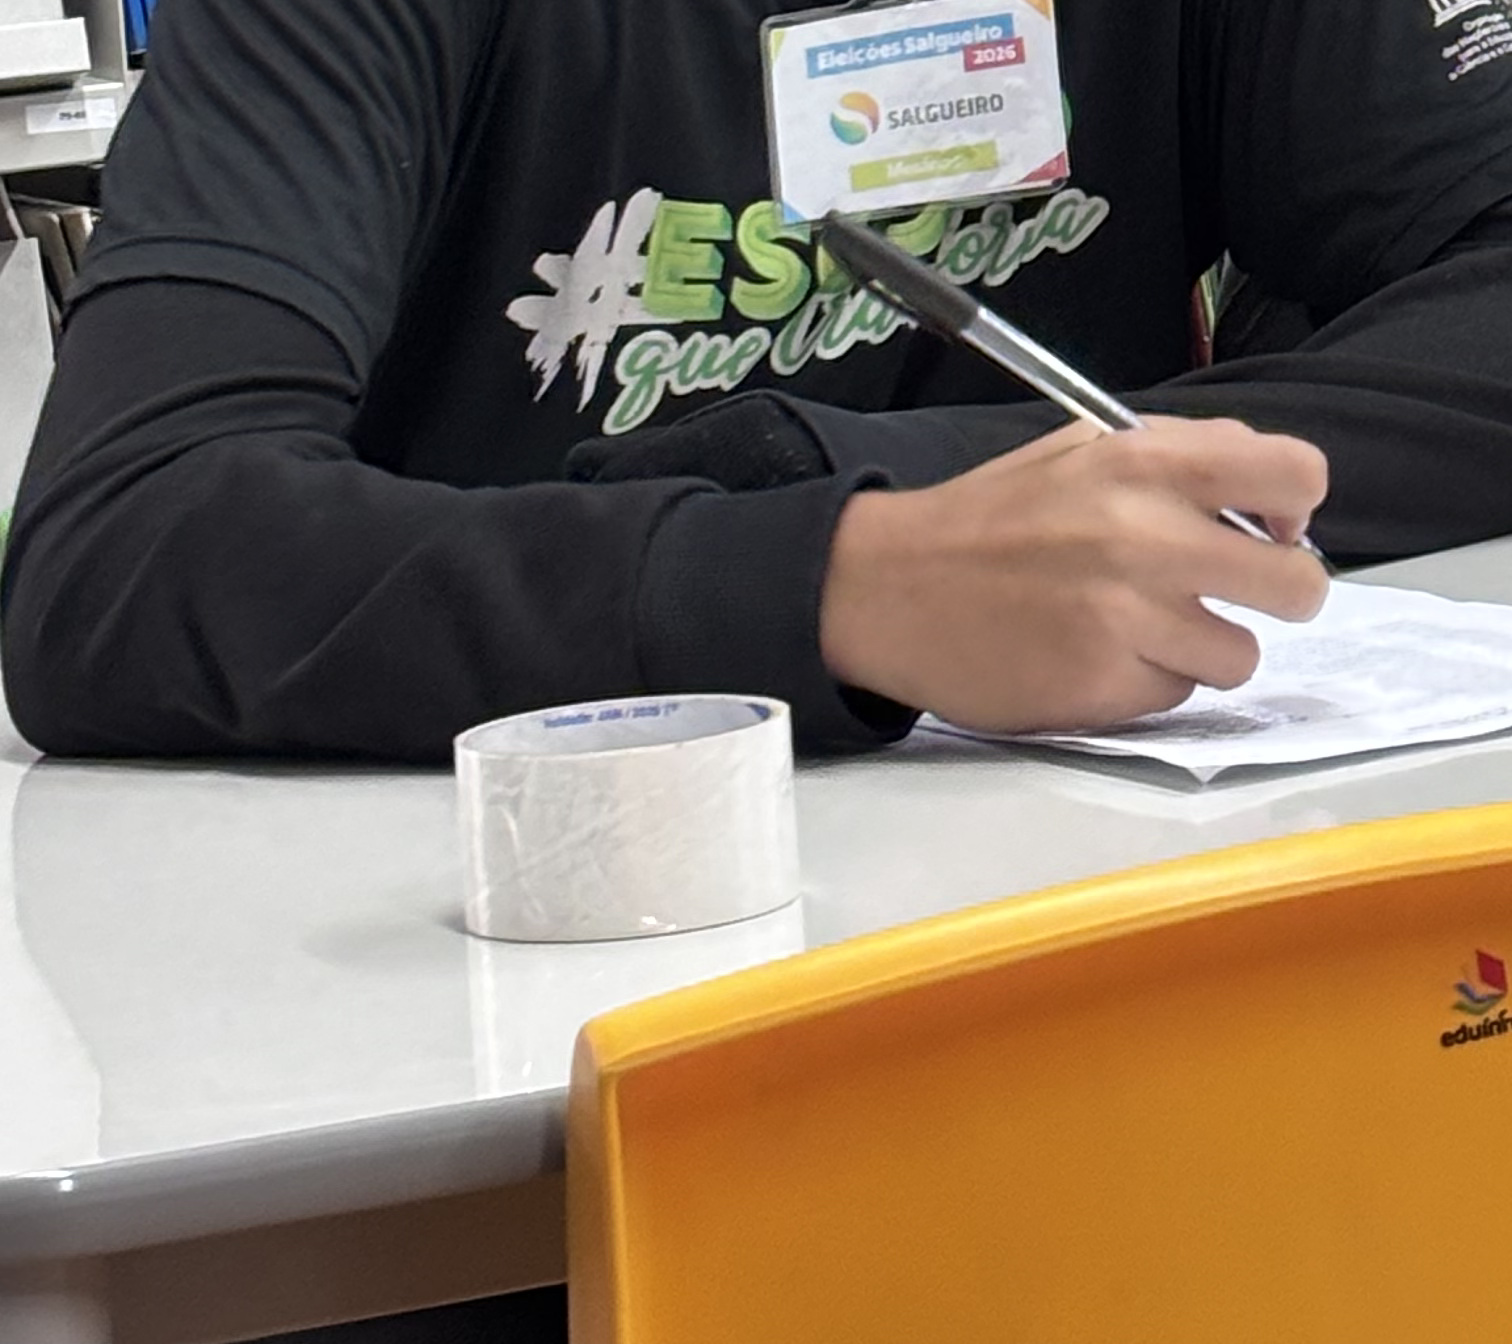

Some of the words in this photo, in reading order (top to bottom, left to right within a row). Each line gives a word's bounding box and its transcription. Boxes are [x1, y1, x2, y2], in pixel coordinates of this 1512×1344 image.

[817, 43, 903, 71] Eleições
[904, 24, 1002, 54] Salgueiro
[973, 46, 1016, 64] 2026
[887, 93, 1003, 129] SALGUEIRO
